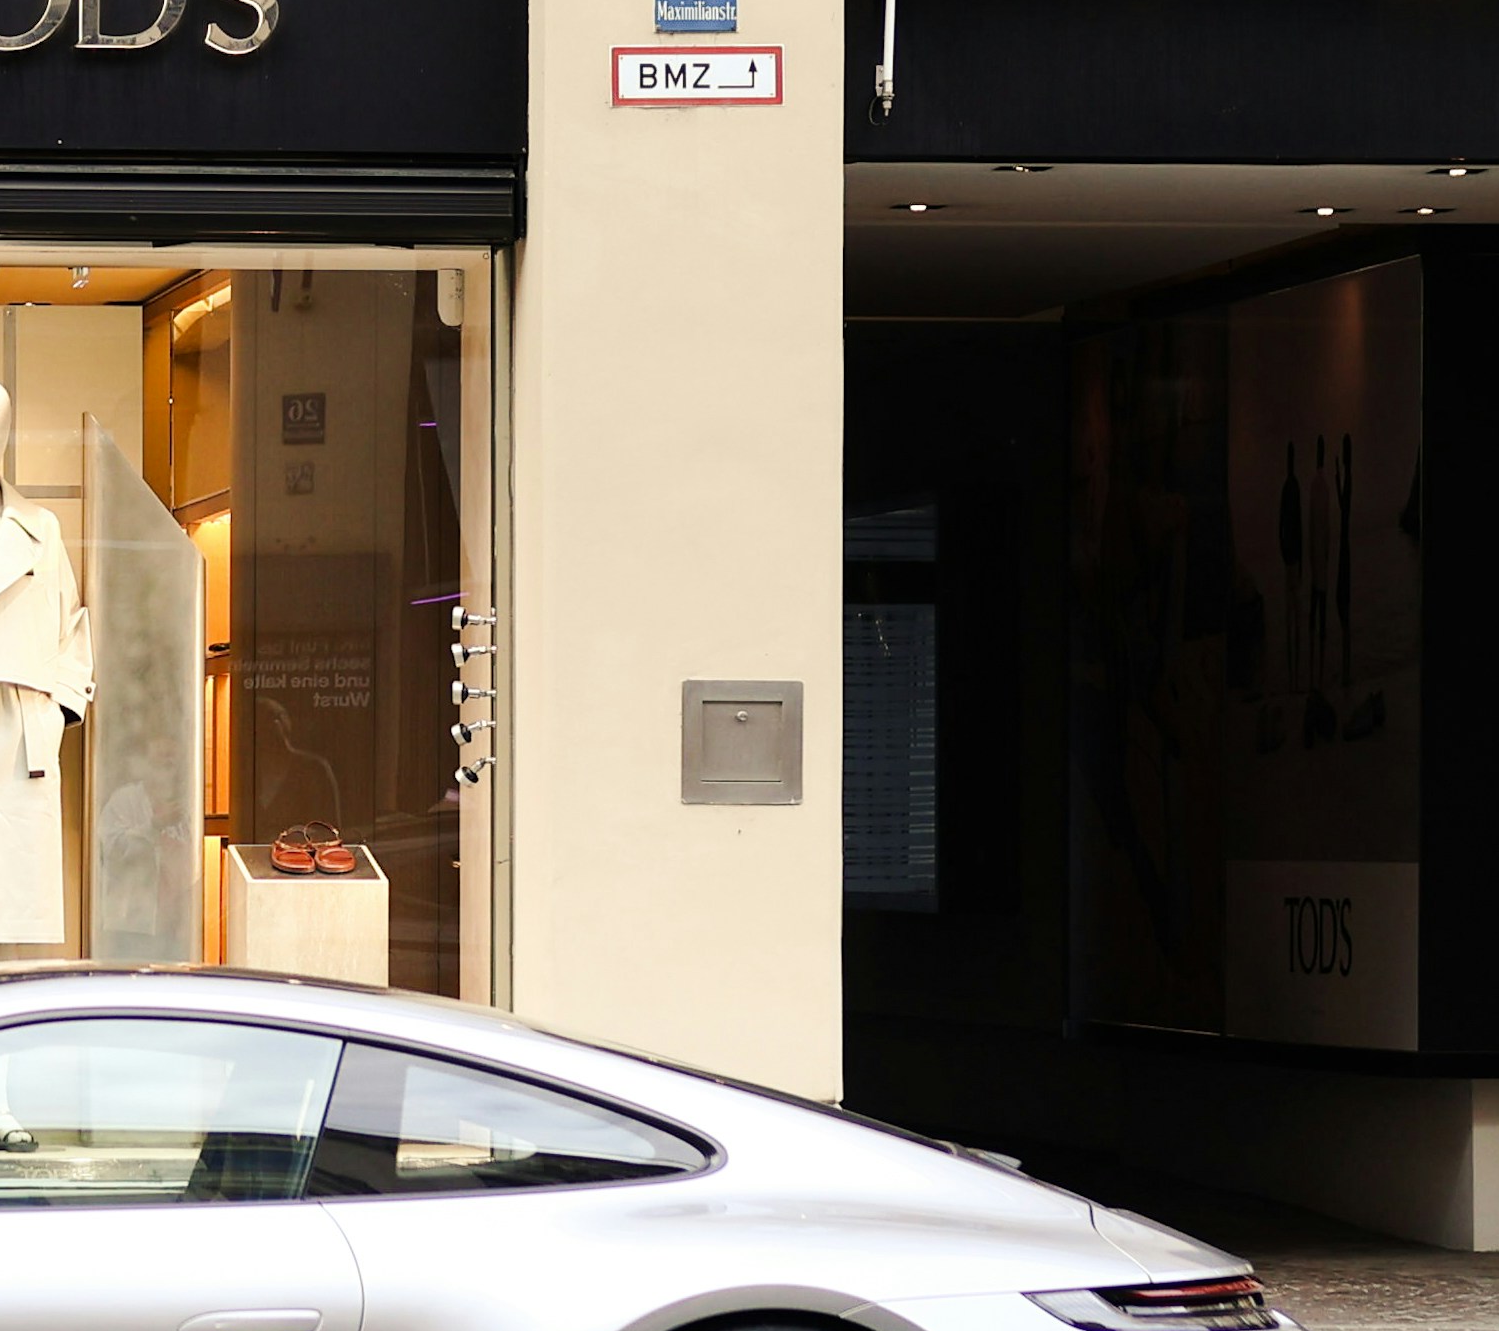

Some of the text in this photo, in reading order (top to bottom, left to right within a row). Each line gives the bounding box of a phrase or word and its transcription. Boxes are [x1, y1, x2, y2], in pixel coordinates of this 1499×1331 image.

[657, 0, 738, 23] Maximilianstr.
[638, 63, 712, 90] BMZ
[1284, 896, 1352, 977] TOD'S
